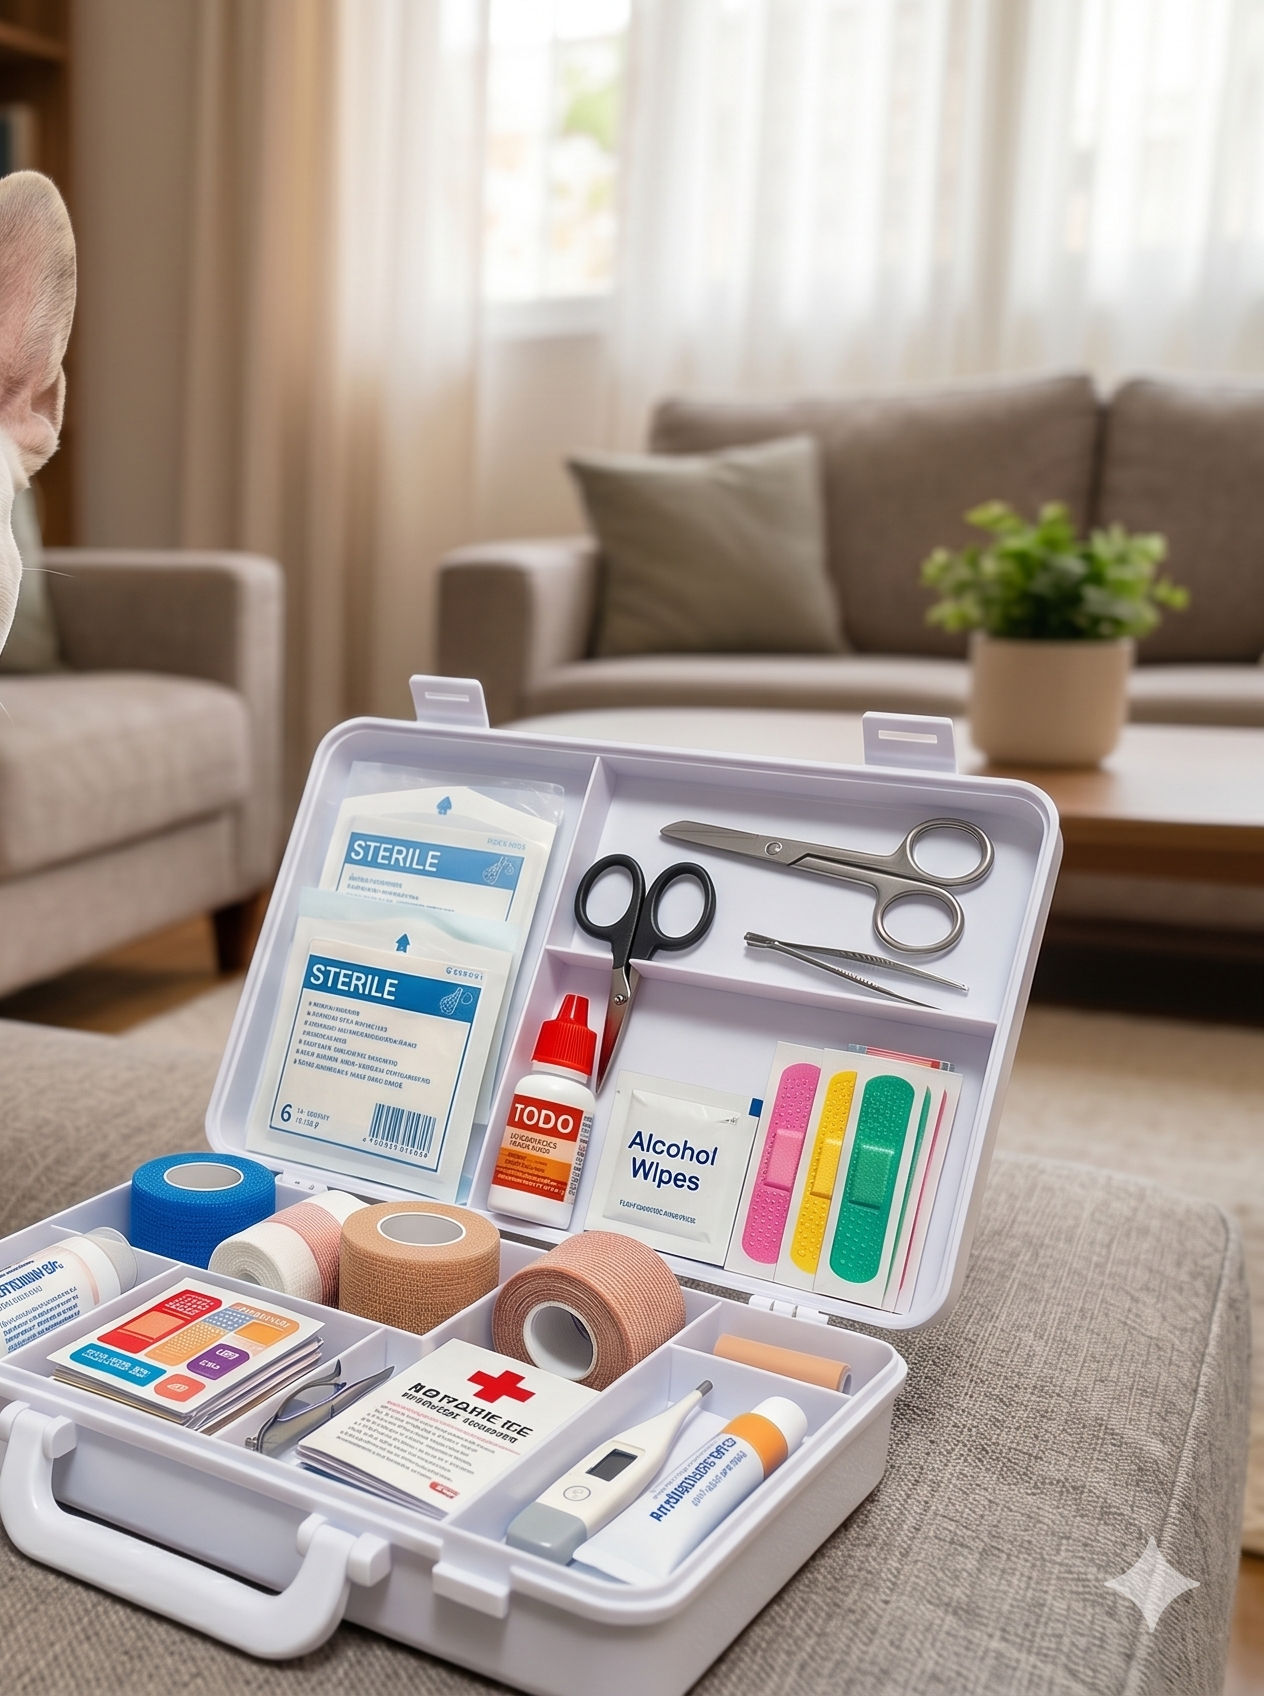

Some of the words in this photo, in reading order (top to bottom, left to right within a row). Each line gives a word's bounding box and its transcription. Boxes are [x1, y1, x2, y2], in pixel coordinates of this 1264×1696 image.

[350, 839, 441, 872] STERILE
[309, 963, 399, 1001] STERILE
[280, 1103, 293, 1123] 6
[514, 1103, 574, 1134] TODO
[628, 1130, 718, 1166] Alcohol
